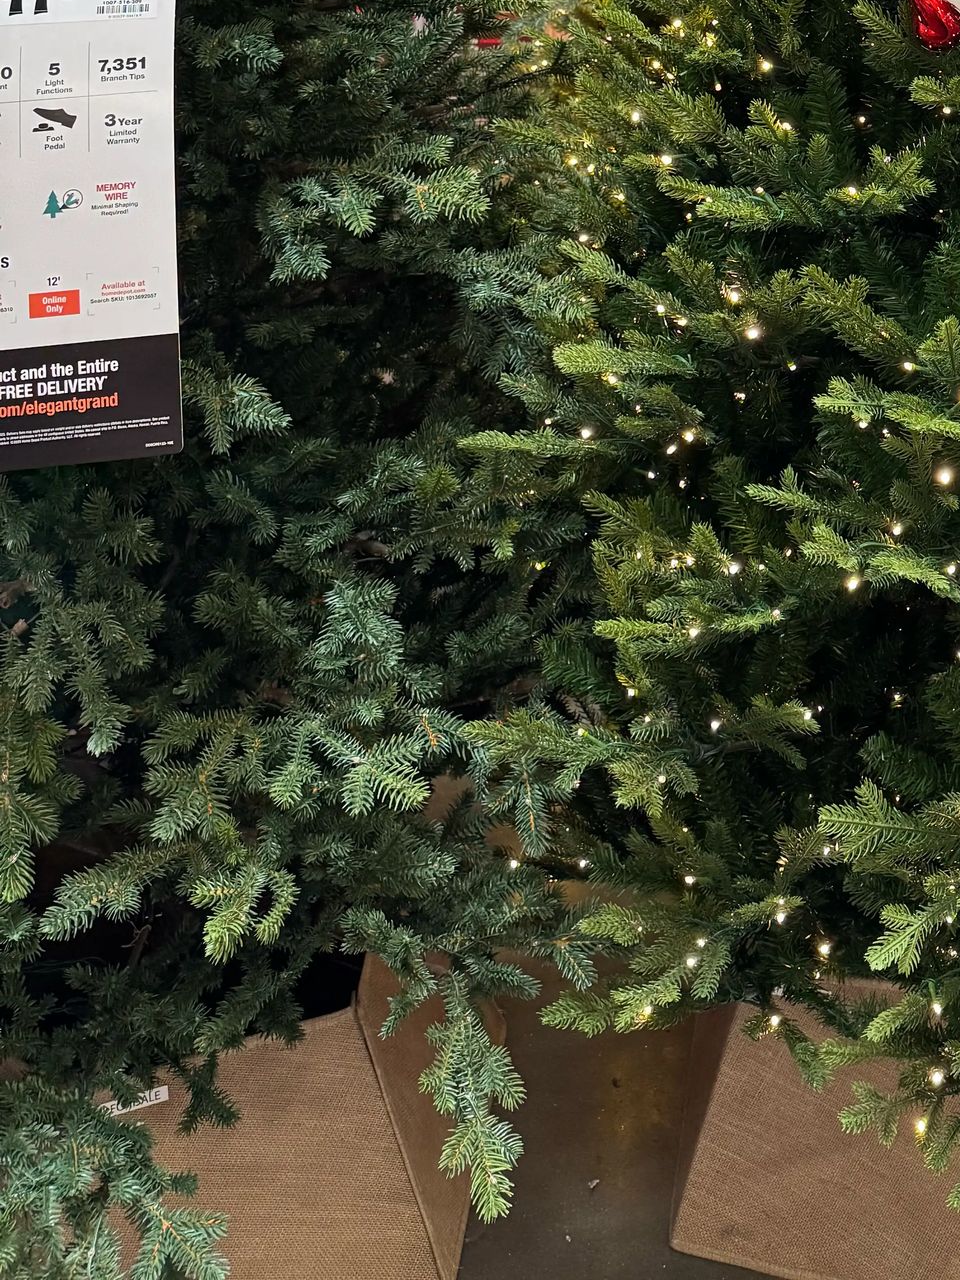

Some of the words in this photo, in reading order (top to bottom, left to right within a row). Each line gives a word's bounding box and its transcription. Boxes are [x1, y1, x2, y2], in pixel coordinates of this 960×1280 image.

[48, 63, 61, 76] 5
[98, 56, 146, 74] 7,351
[100, 74, 128, 82] Branch
[129, 73, 145, 82] Tips
[45, 79, 64, 87] Light
[36, 86, 73, 95] Functions
[104, 113, 116, 127] 3
[117, 117, 143, 126] Year
[109, 128, 137, 137] Limited
[44, 142, 66, 151] Pedal
[107, 137, 140, 146] Warranty
[96, 181, 137, 193] MEMORY
[104, 191, 128, 201] WIRE
[91, 202, 114, 211] Minimal
[115, 201, 139, 210] Shaping
[101, 208, 129, 217] Required!
[46, 276, 61, 287] 12'
[101, 281, 136, 290] Available
[101, 288, 146, 297] homedepot.com
[42, 295, 67, 306] Online
[90, 297, 110, 305] Search
[45, 304, 63, 314] Only
[20, 364, 47, 380] and
[50, 362, 74, 377] the
[78, 358, 119, 375] Entire
[0, 383, 33, 400] FREE
